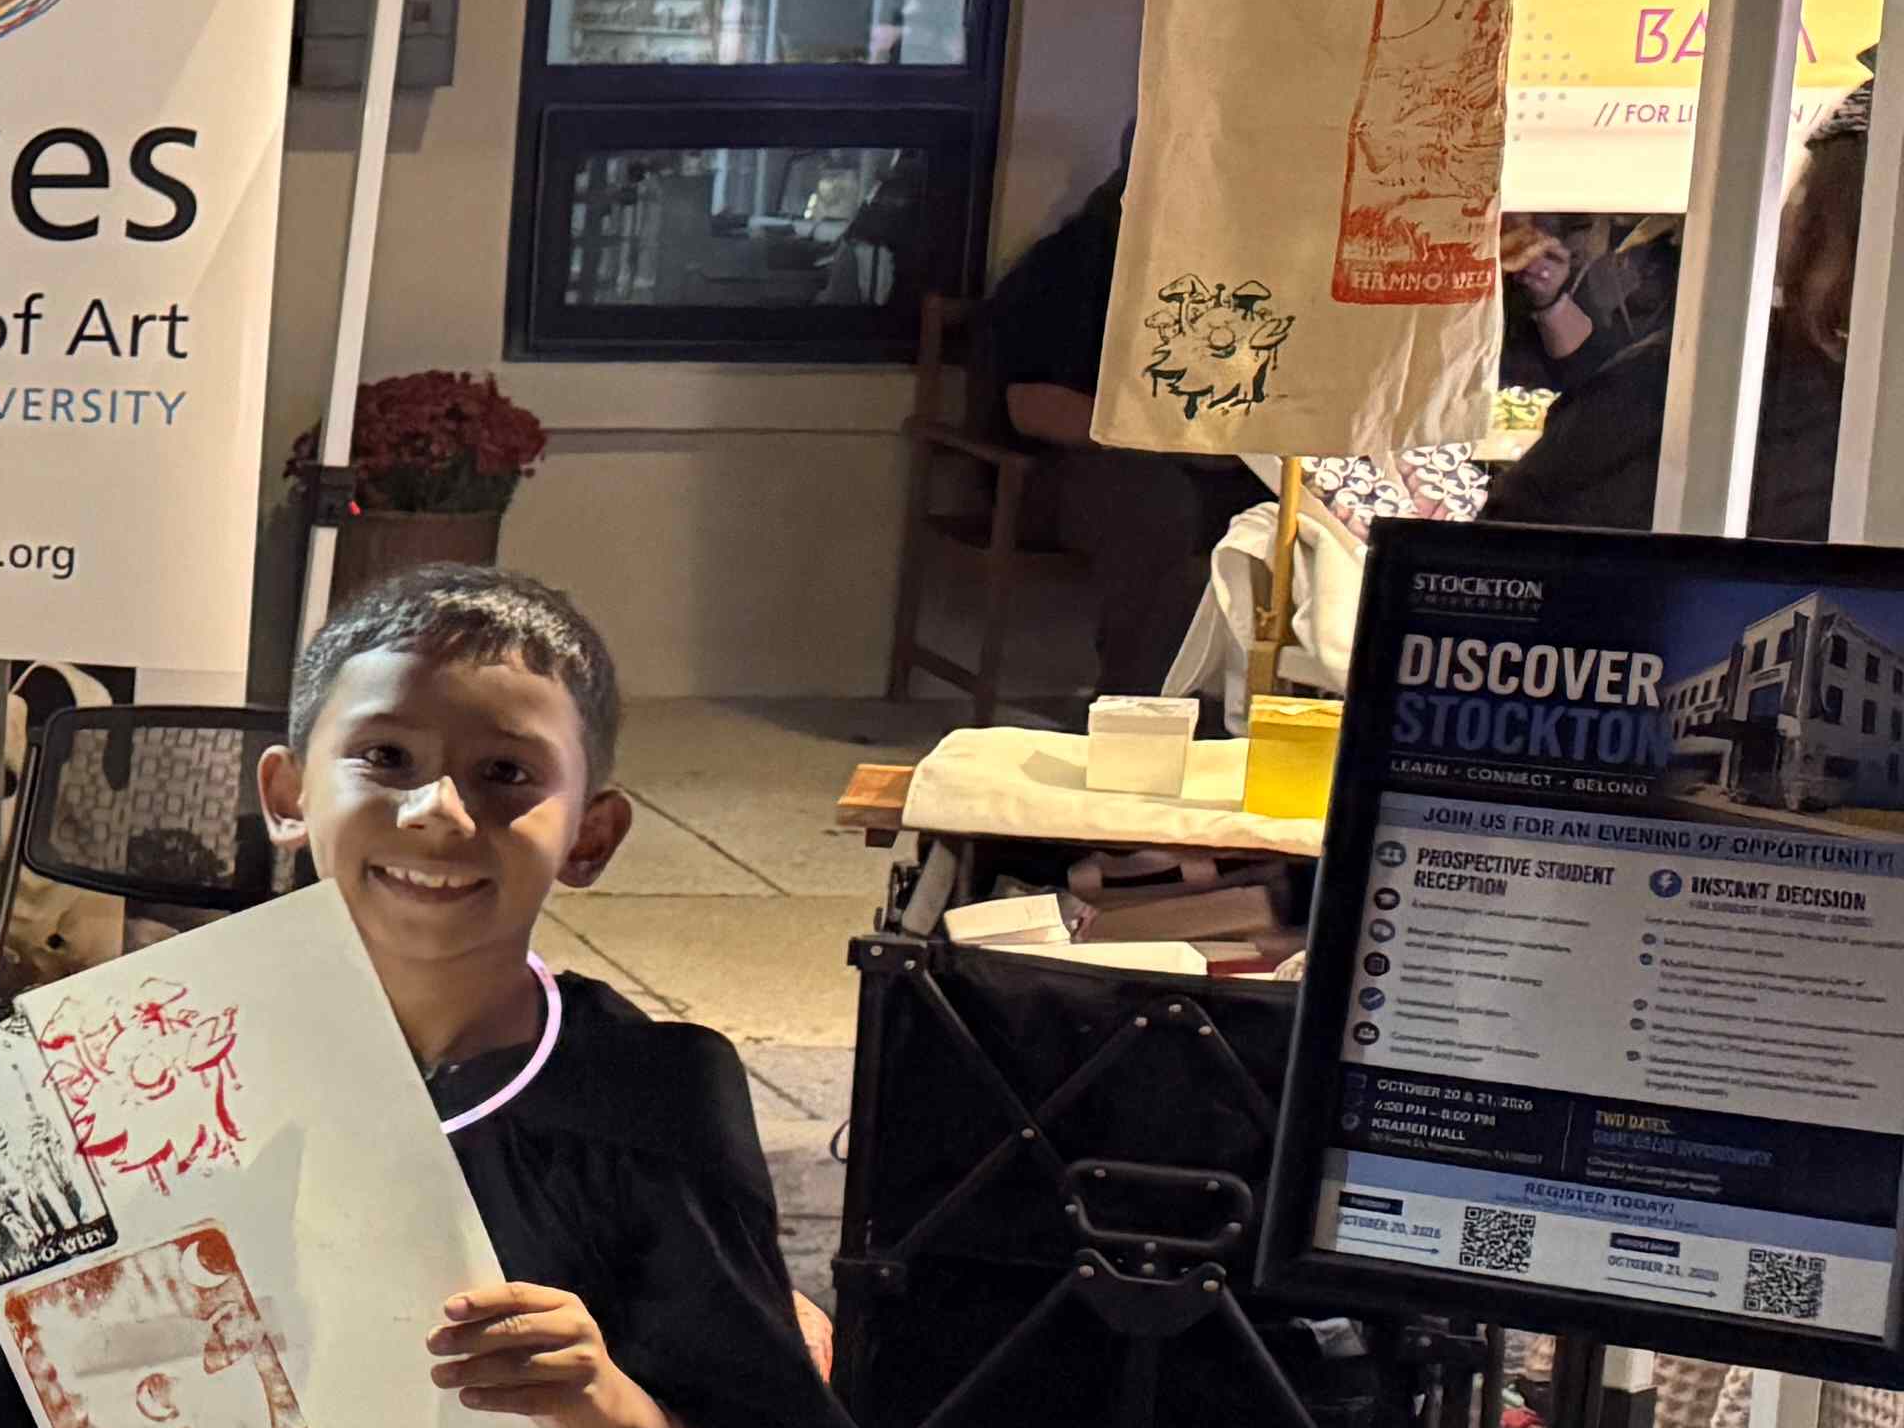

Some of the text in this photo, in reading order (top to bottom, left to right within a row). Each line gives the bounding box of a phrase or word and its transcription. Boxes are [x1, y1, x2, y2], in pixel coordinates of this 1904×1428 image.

[1625, 103, 1670, 124] FOR
[65, 297, 189, 360] Art
[1413, 571, 1543, 599] STOCKTON
[1397, 634, 1665, 707] DISCOVER
[1392, 692, 1670, 768] STOCKTON
[1391, 758, 1650, 797] LEARN CONNECT BELONG
[1422, 807, 1474, 829] JOIN
[1478, 809, 1507, 829] US
[1513, 814, 1555, 837] FOR
[1560, 819, 1591, 840] AN
[1596, 823, 1692, 851] EVENING
[1698, 834, 1728, 854] OF
[1413, 869, 1509, 897] RECEPTION
[1416, 846, 1616, 886] PROSPECTIVE STUDENT
[1690, 875, 1868, 912] INSTANT DECISION
[1431, 1124, 1467, 1142] HALL
[1523, 1182, 1608, 1205] REGISTER
